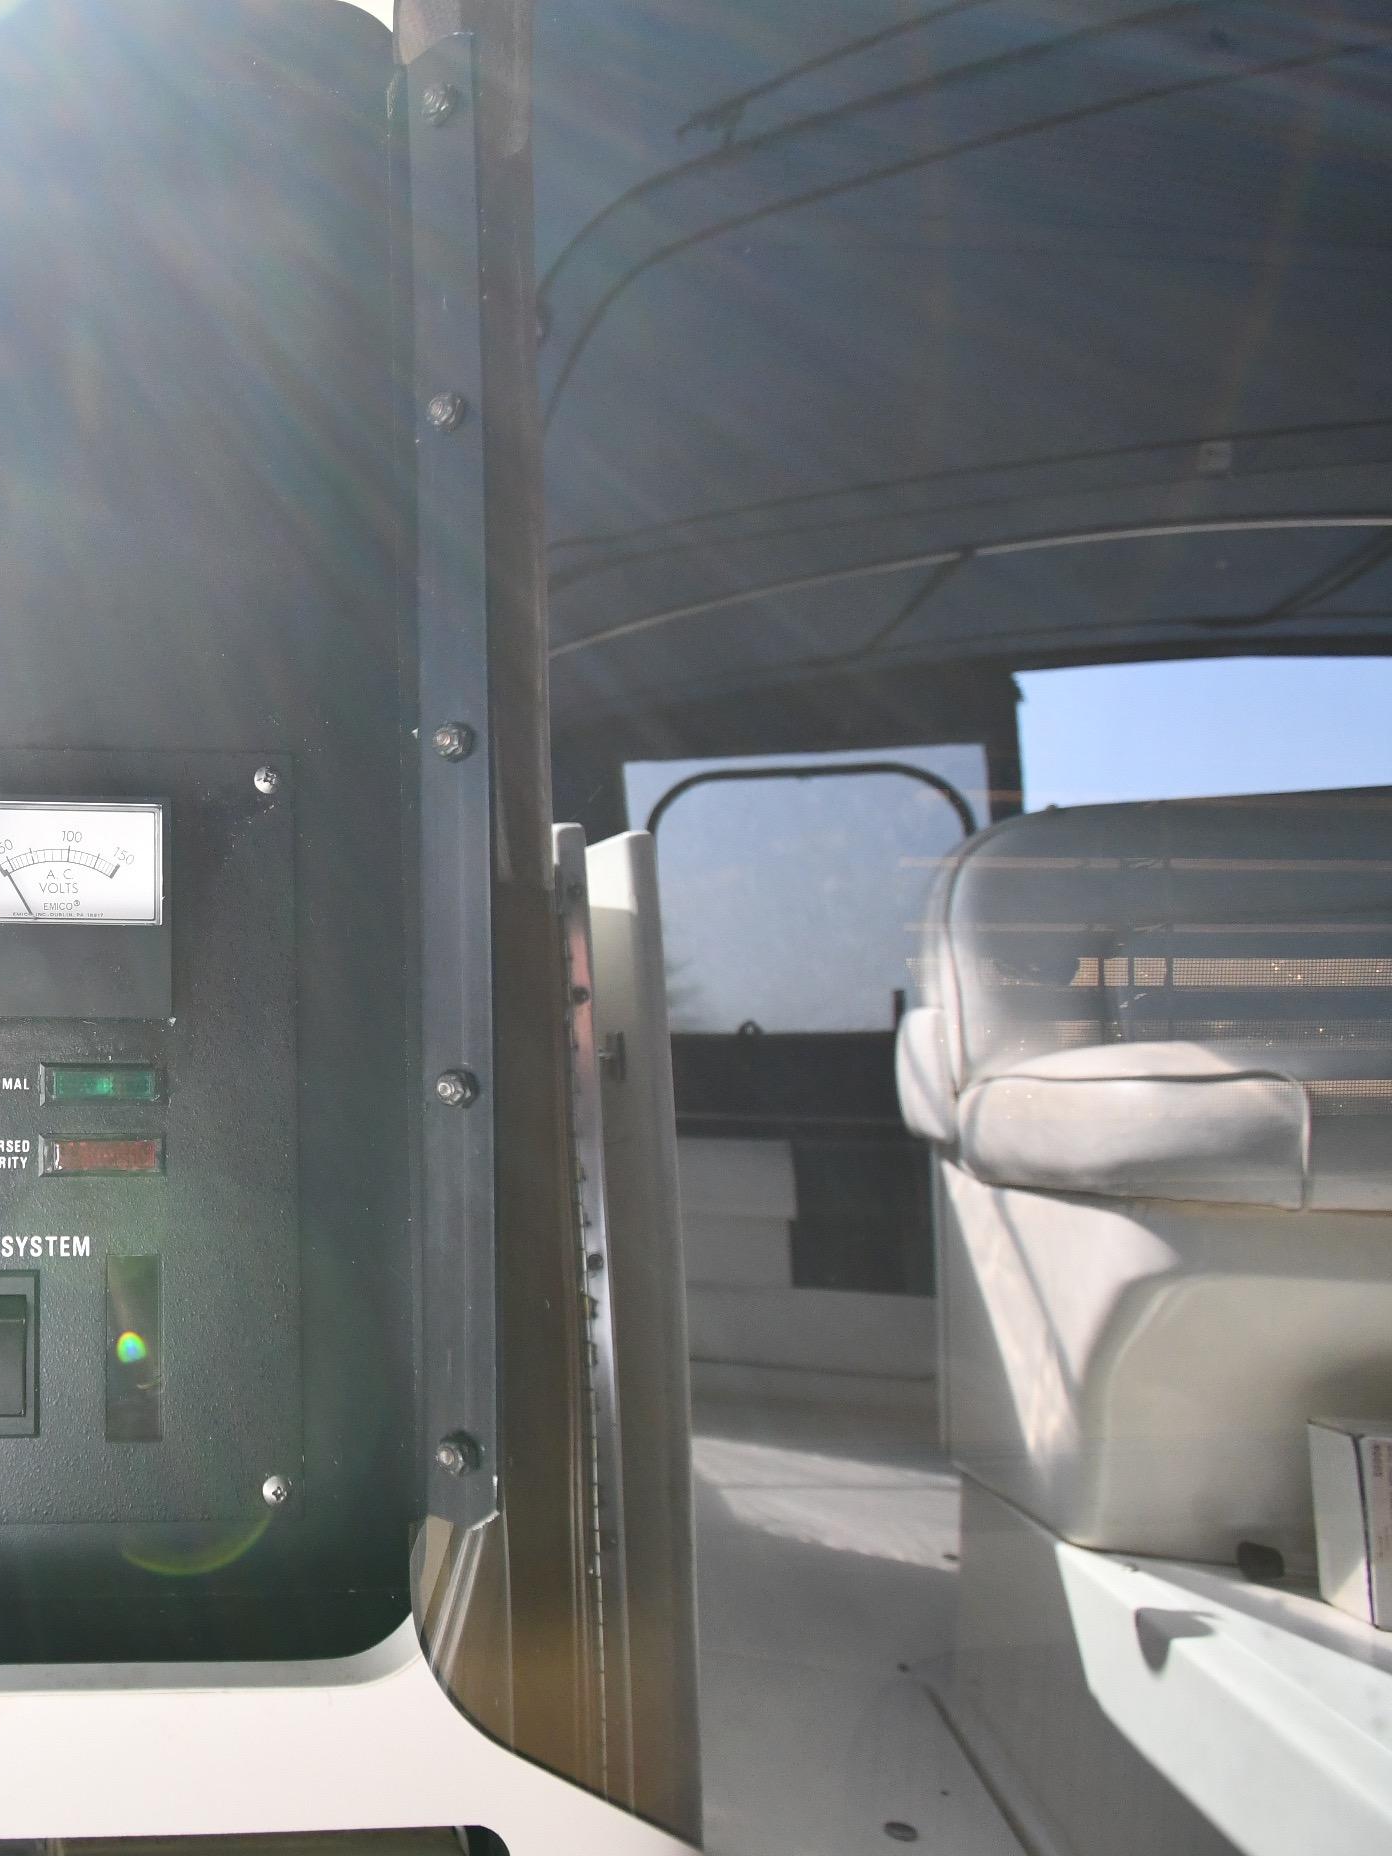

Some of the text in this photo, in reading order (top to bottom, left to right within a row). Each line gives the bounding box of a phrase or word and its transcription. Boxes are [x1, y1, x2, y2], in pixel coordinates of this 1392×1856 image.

[61, 830, 83, 843] 100
[112, 846, 135, 866] 150
[38, 882, 79, 894] VOLTS
[1, 1235, 90, 1258] SYSTEM
